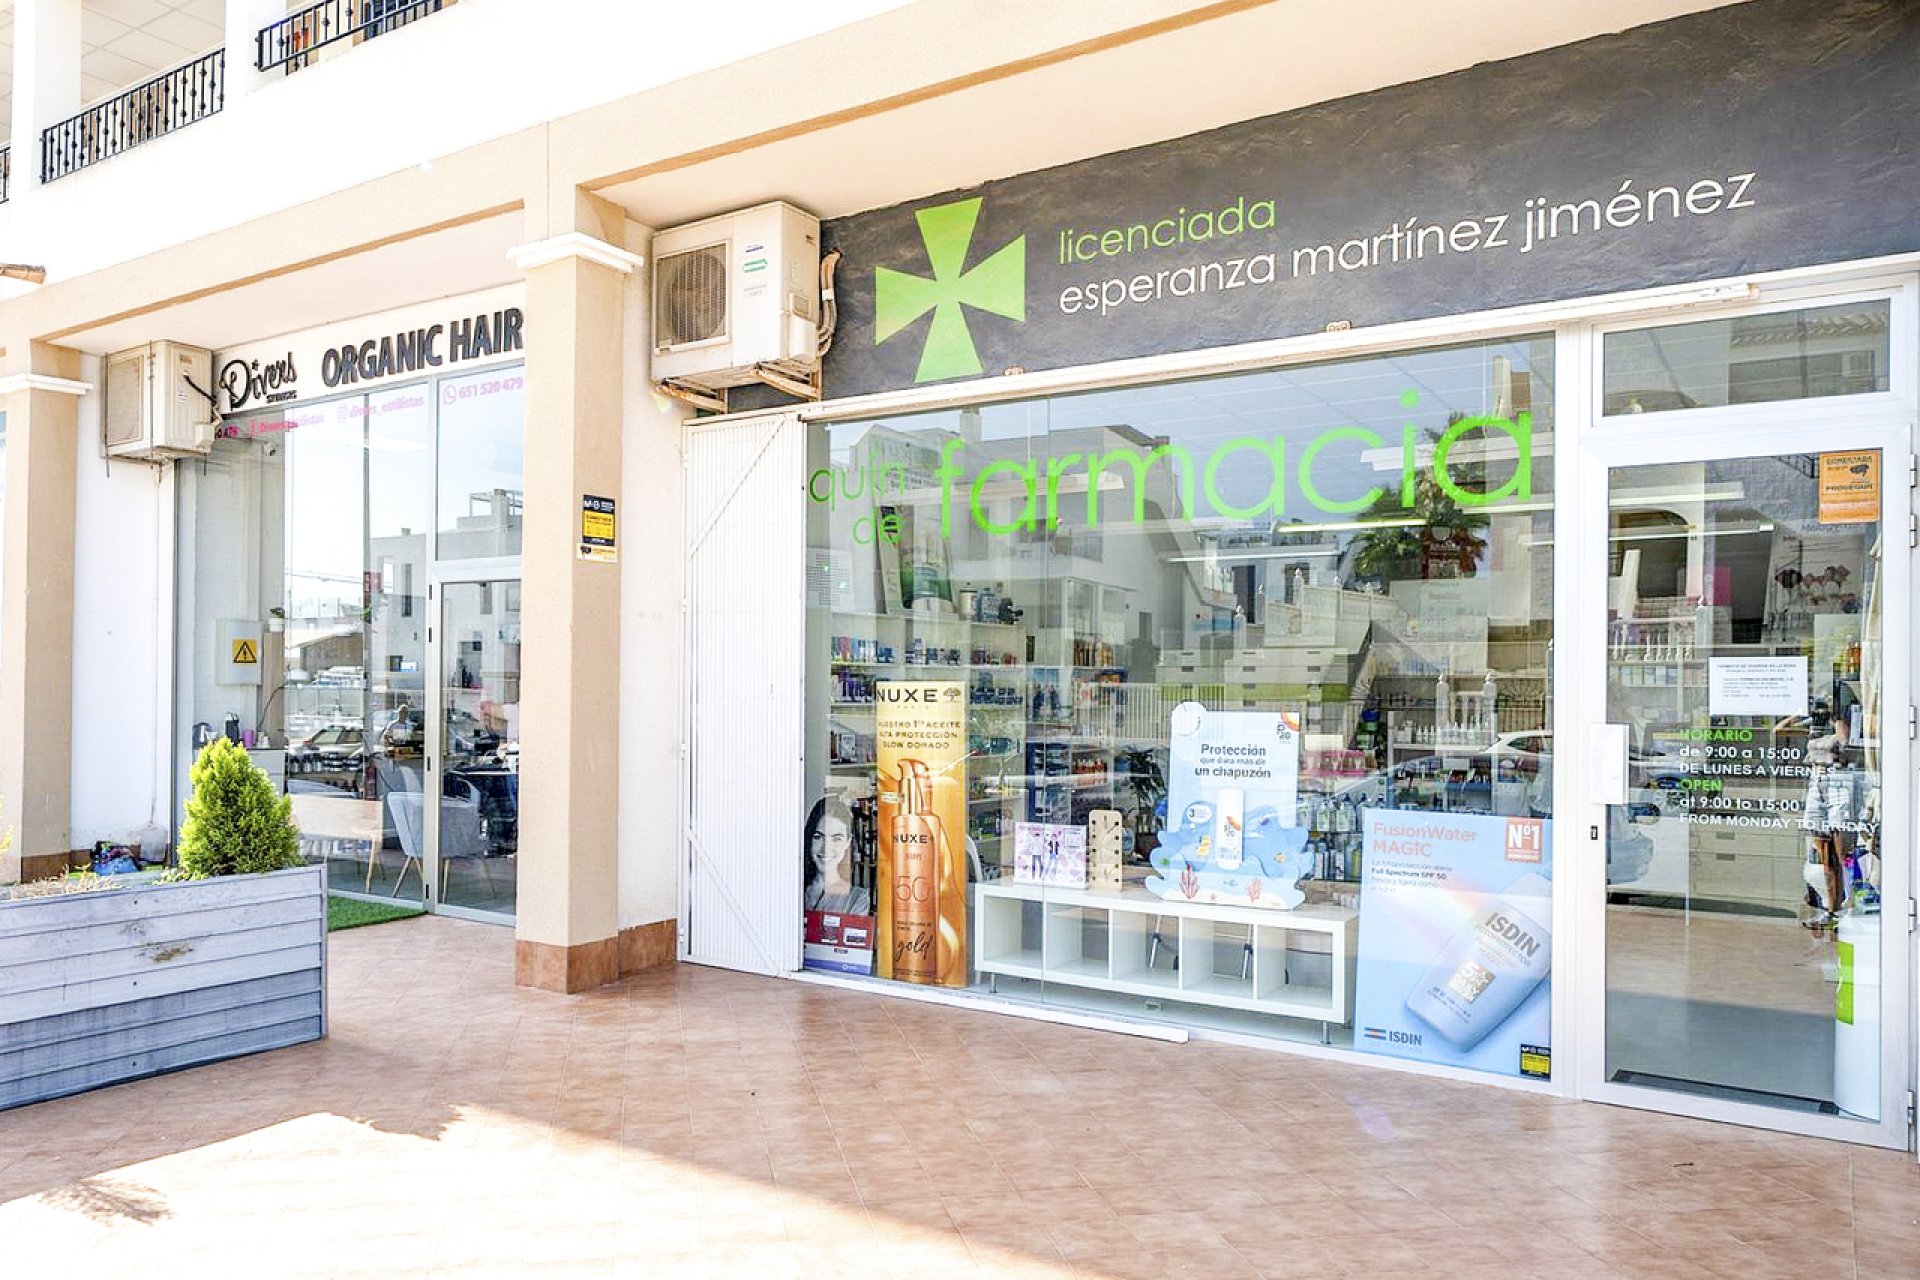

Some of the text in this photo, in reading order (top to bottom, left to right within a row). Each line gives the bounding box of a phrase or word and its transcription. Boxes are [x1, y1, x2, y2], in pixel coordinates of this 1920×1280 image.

[1058, 196, 1276, 265] licenciada
[1059, 172, 1757, 316] esperanza martínez jiménez
[322, 307, 524, 388] ORGANIC HAIR
[932, 388, 1535, 541] farmacia
[852, 505, 904, 546] de
[877, 688, 938, 702] NUXE
[1679, 729, 1753, 742] HORARIO
[1201, 743, 1267, 756] Protección
[1680, 745, 1801, 760] de 9:00 a 15:00
[1195, 767, 1272, 780] un chapuzón
[1680, 764, 1837, 778] DE LUNES A VIERNES
[1680, 779, 1723, 791] OPEN
[1680, 797, 1800, 811] at 9:00 to 15:00
[1680, 813, 1879, 834] FROM MONDAY TO FRIDAY
[892, 833, 928, 844] NUXE
[1485, 911, 1540, 958] ISDIN
[895, 931, 934, 962] gold
[1388, 1029, 1423, 1047] ISDIN
